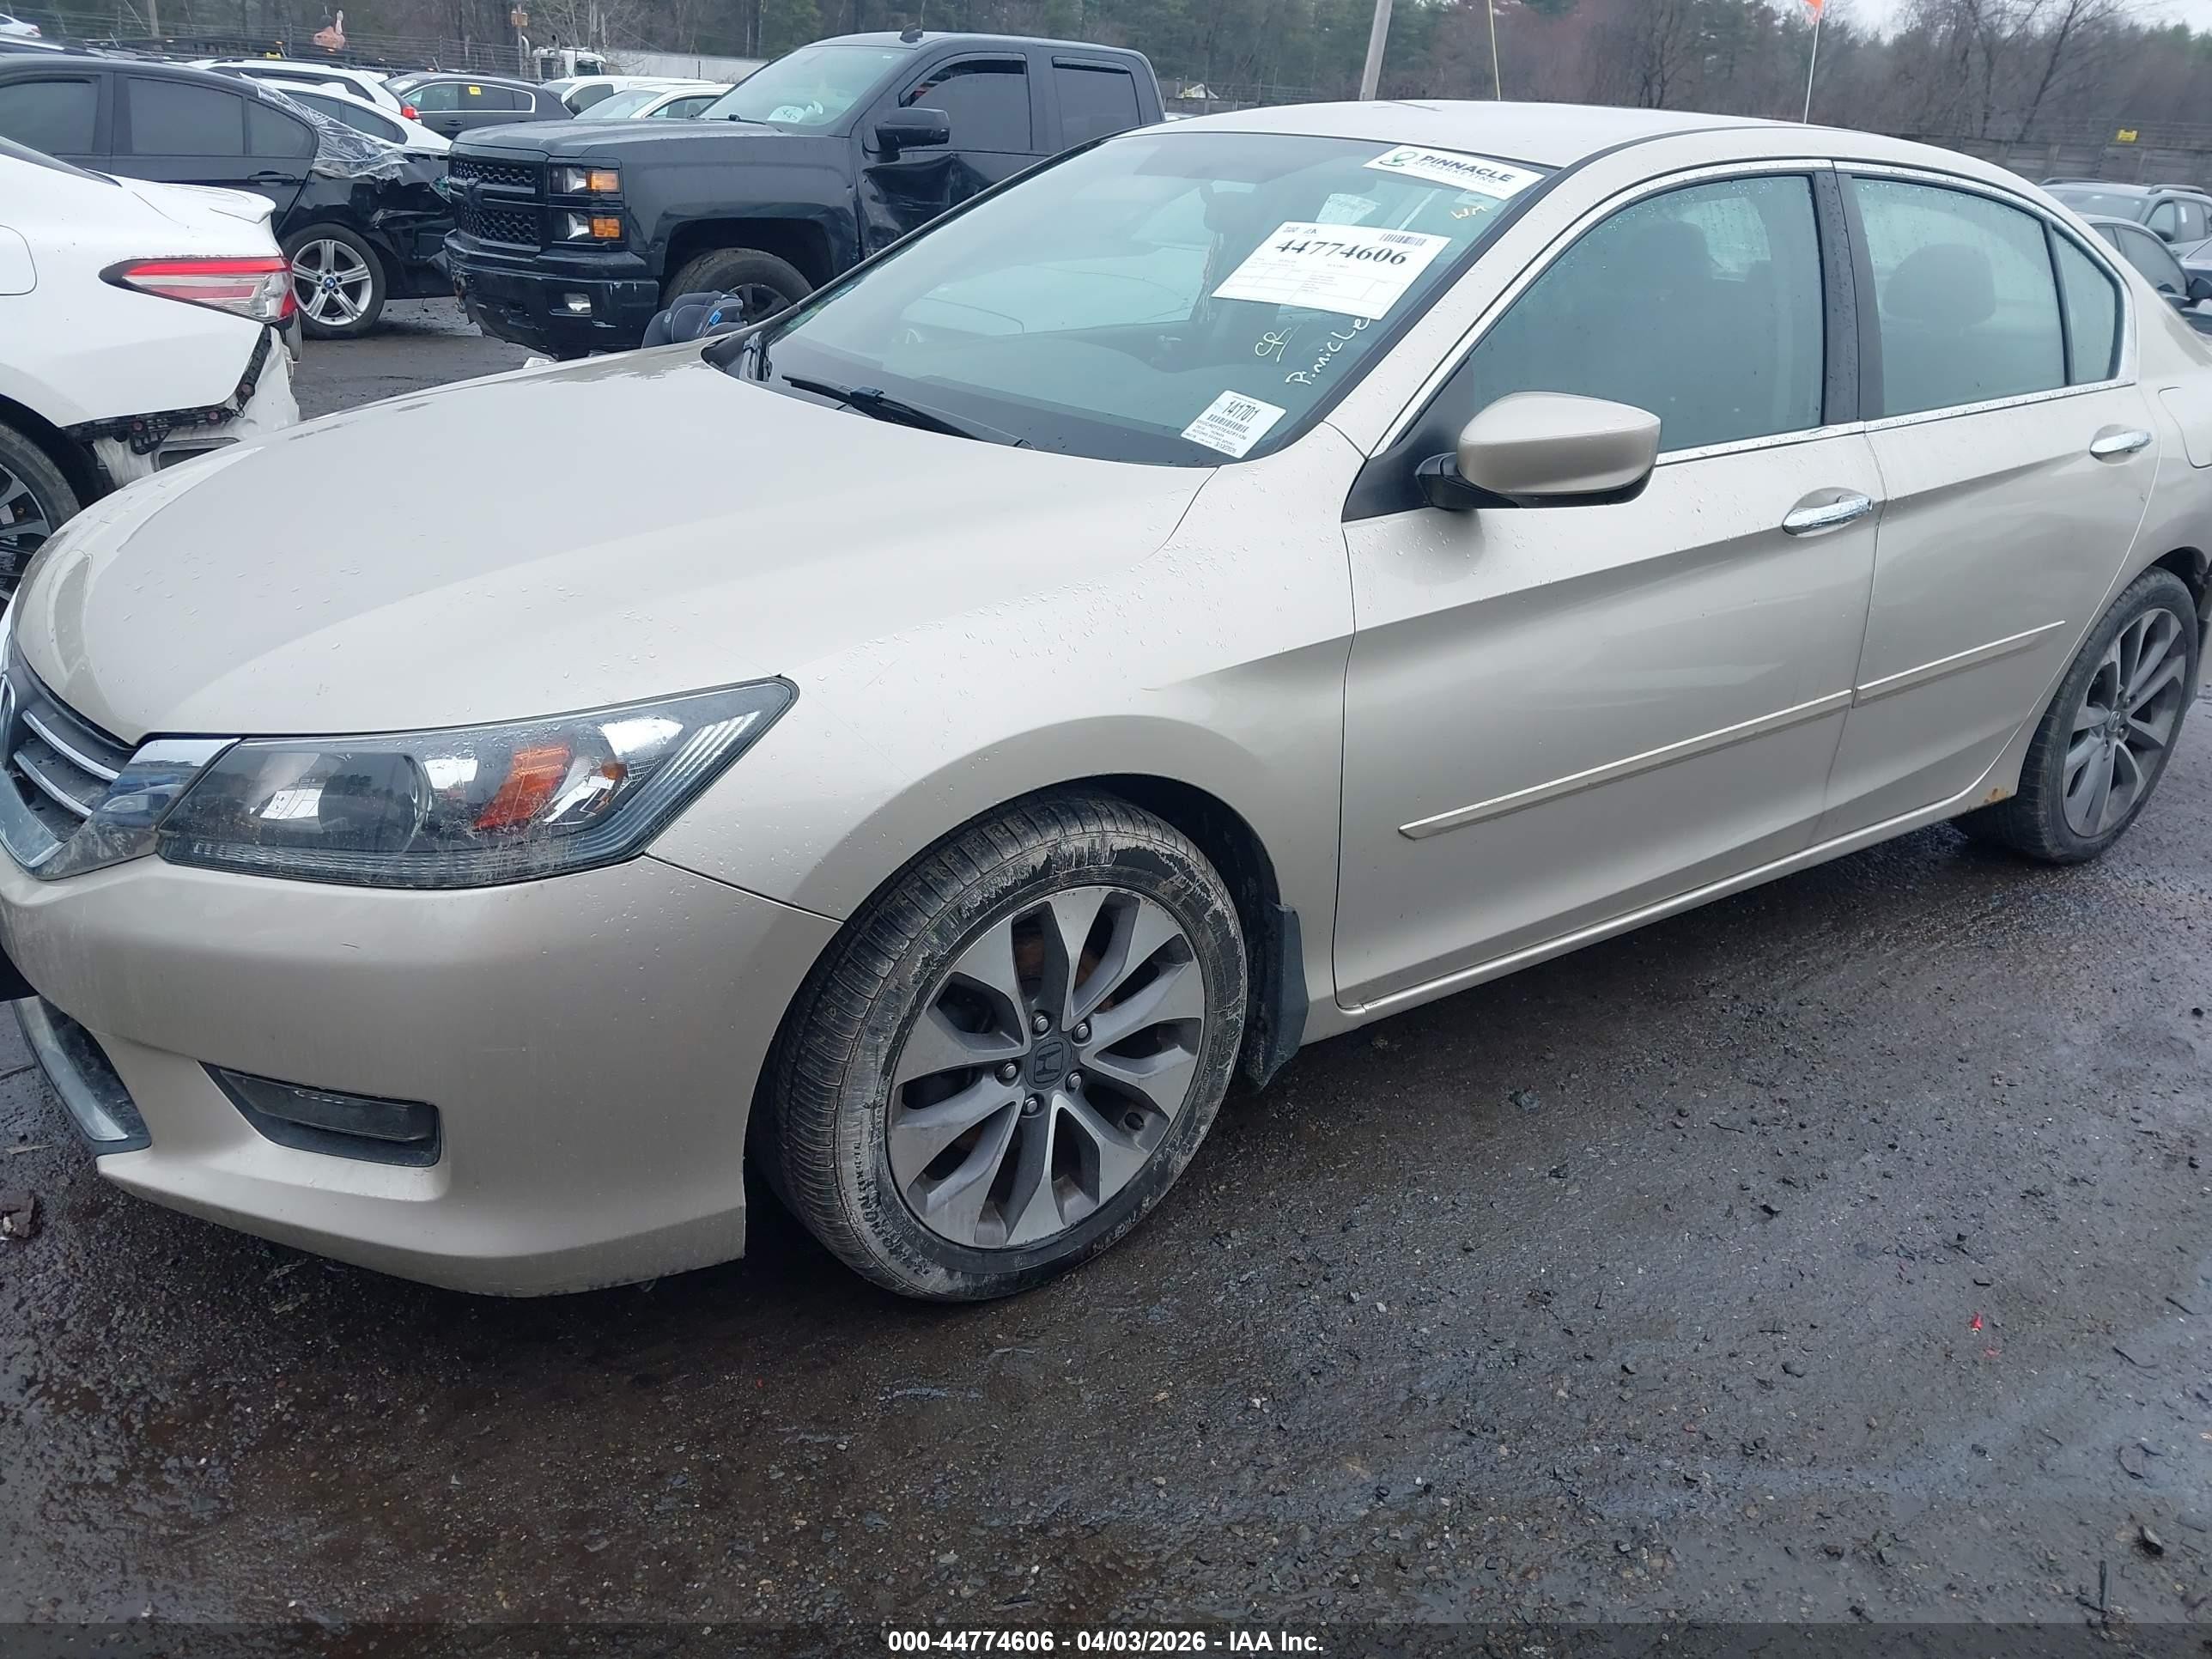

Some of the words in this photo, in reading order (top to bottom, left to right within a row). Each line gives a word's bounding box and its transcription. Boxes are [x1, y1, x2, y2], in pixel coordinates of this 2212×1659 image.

[1419, 155, 1516, 182] PINNACLE
[1275, 239, 1414, 265] 44774606
[1221, 399, 1262, 422] 141701
